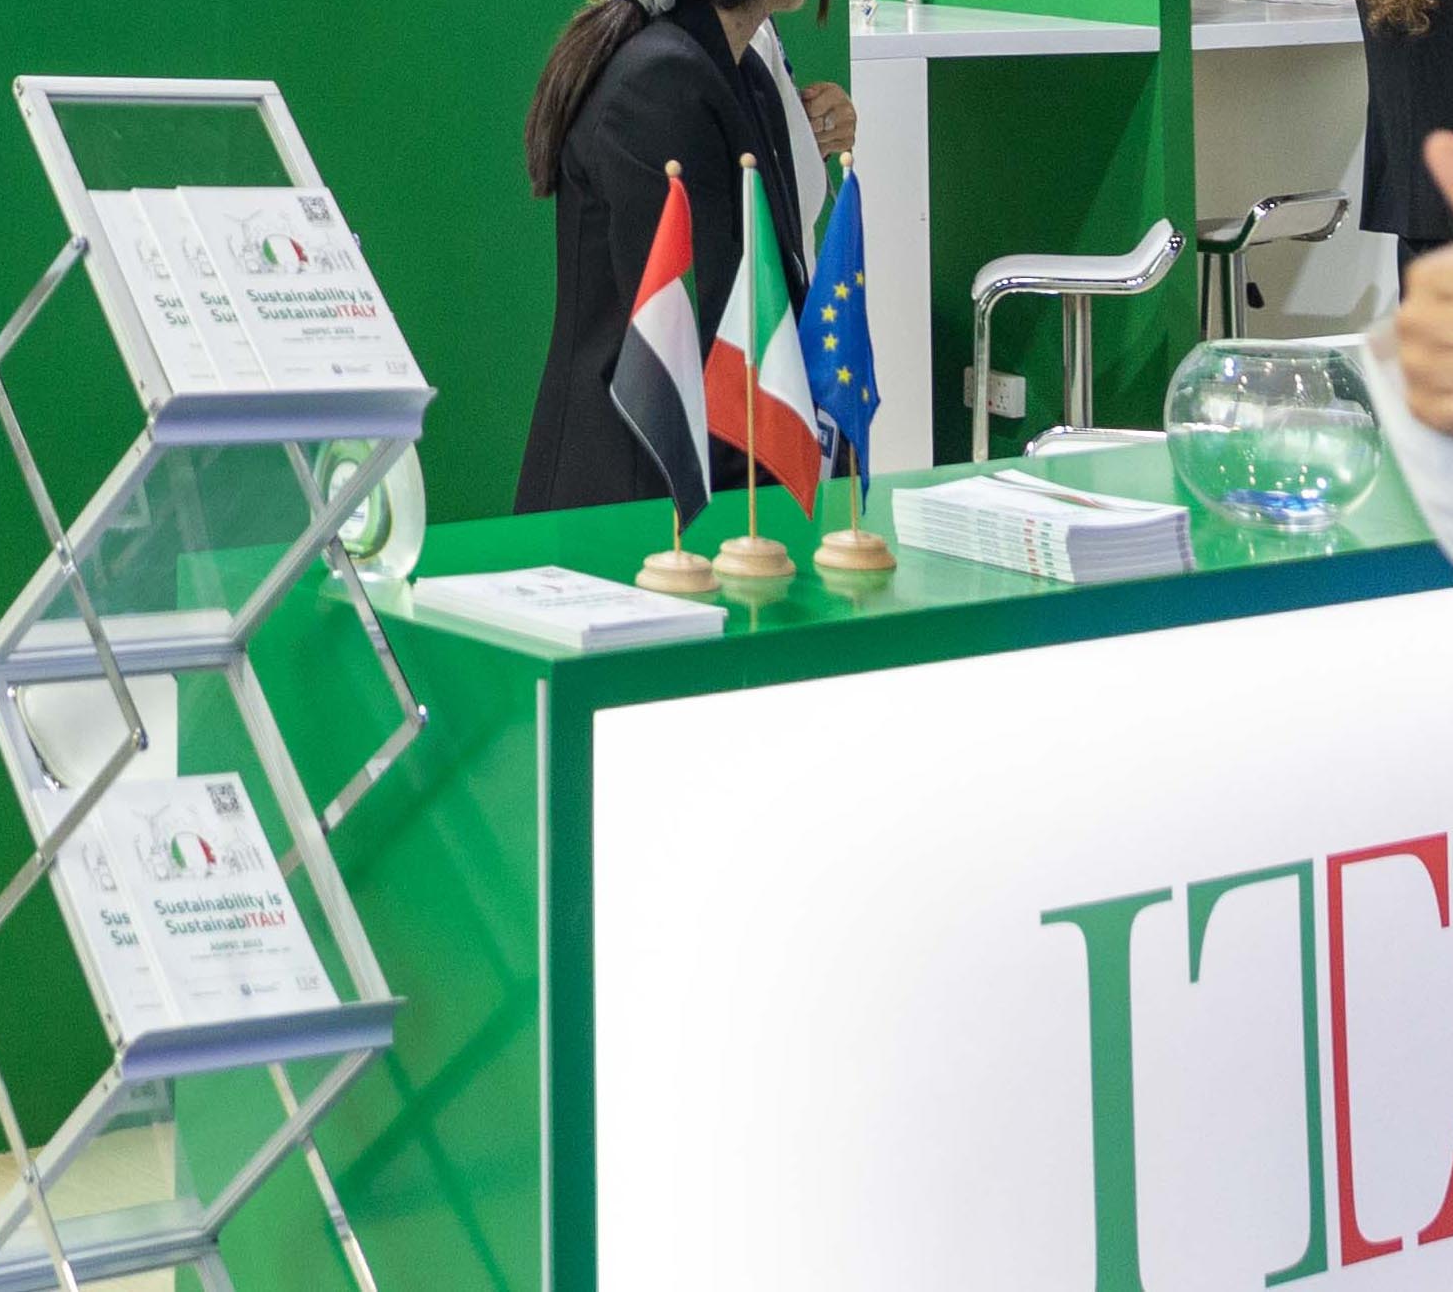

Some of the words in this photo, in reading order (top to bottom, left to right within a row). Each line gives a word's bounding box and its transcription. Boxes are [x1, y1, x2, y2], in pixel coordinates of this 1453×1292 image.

[246, 288, 356, 304] Sustainability
[359, 288, 373, 301] is
[257, 304, 377, 320] SustainabITALY
[153, 893, 265, 916] Sustainability
[267, 890, 282, 906] is
[165, 910, 286, 935] SustainabITALY
